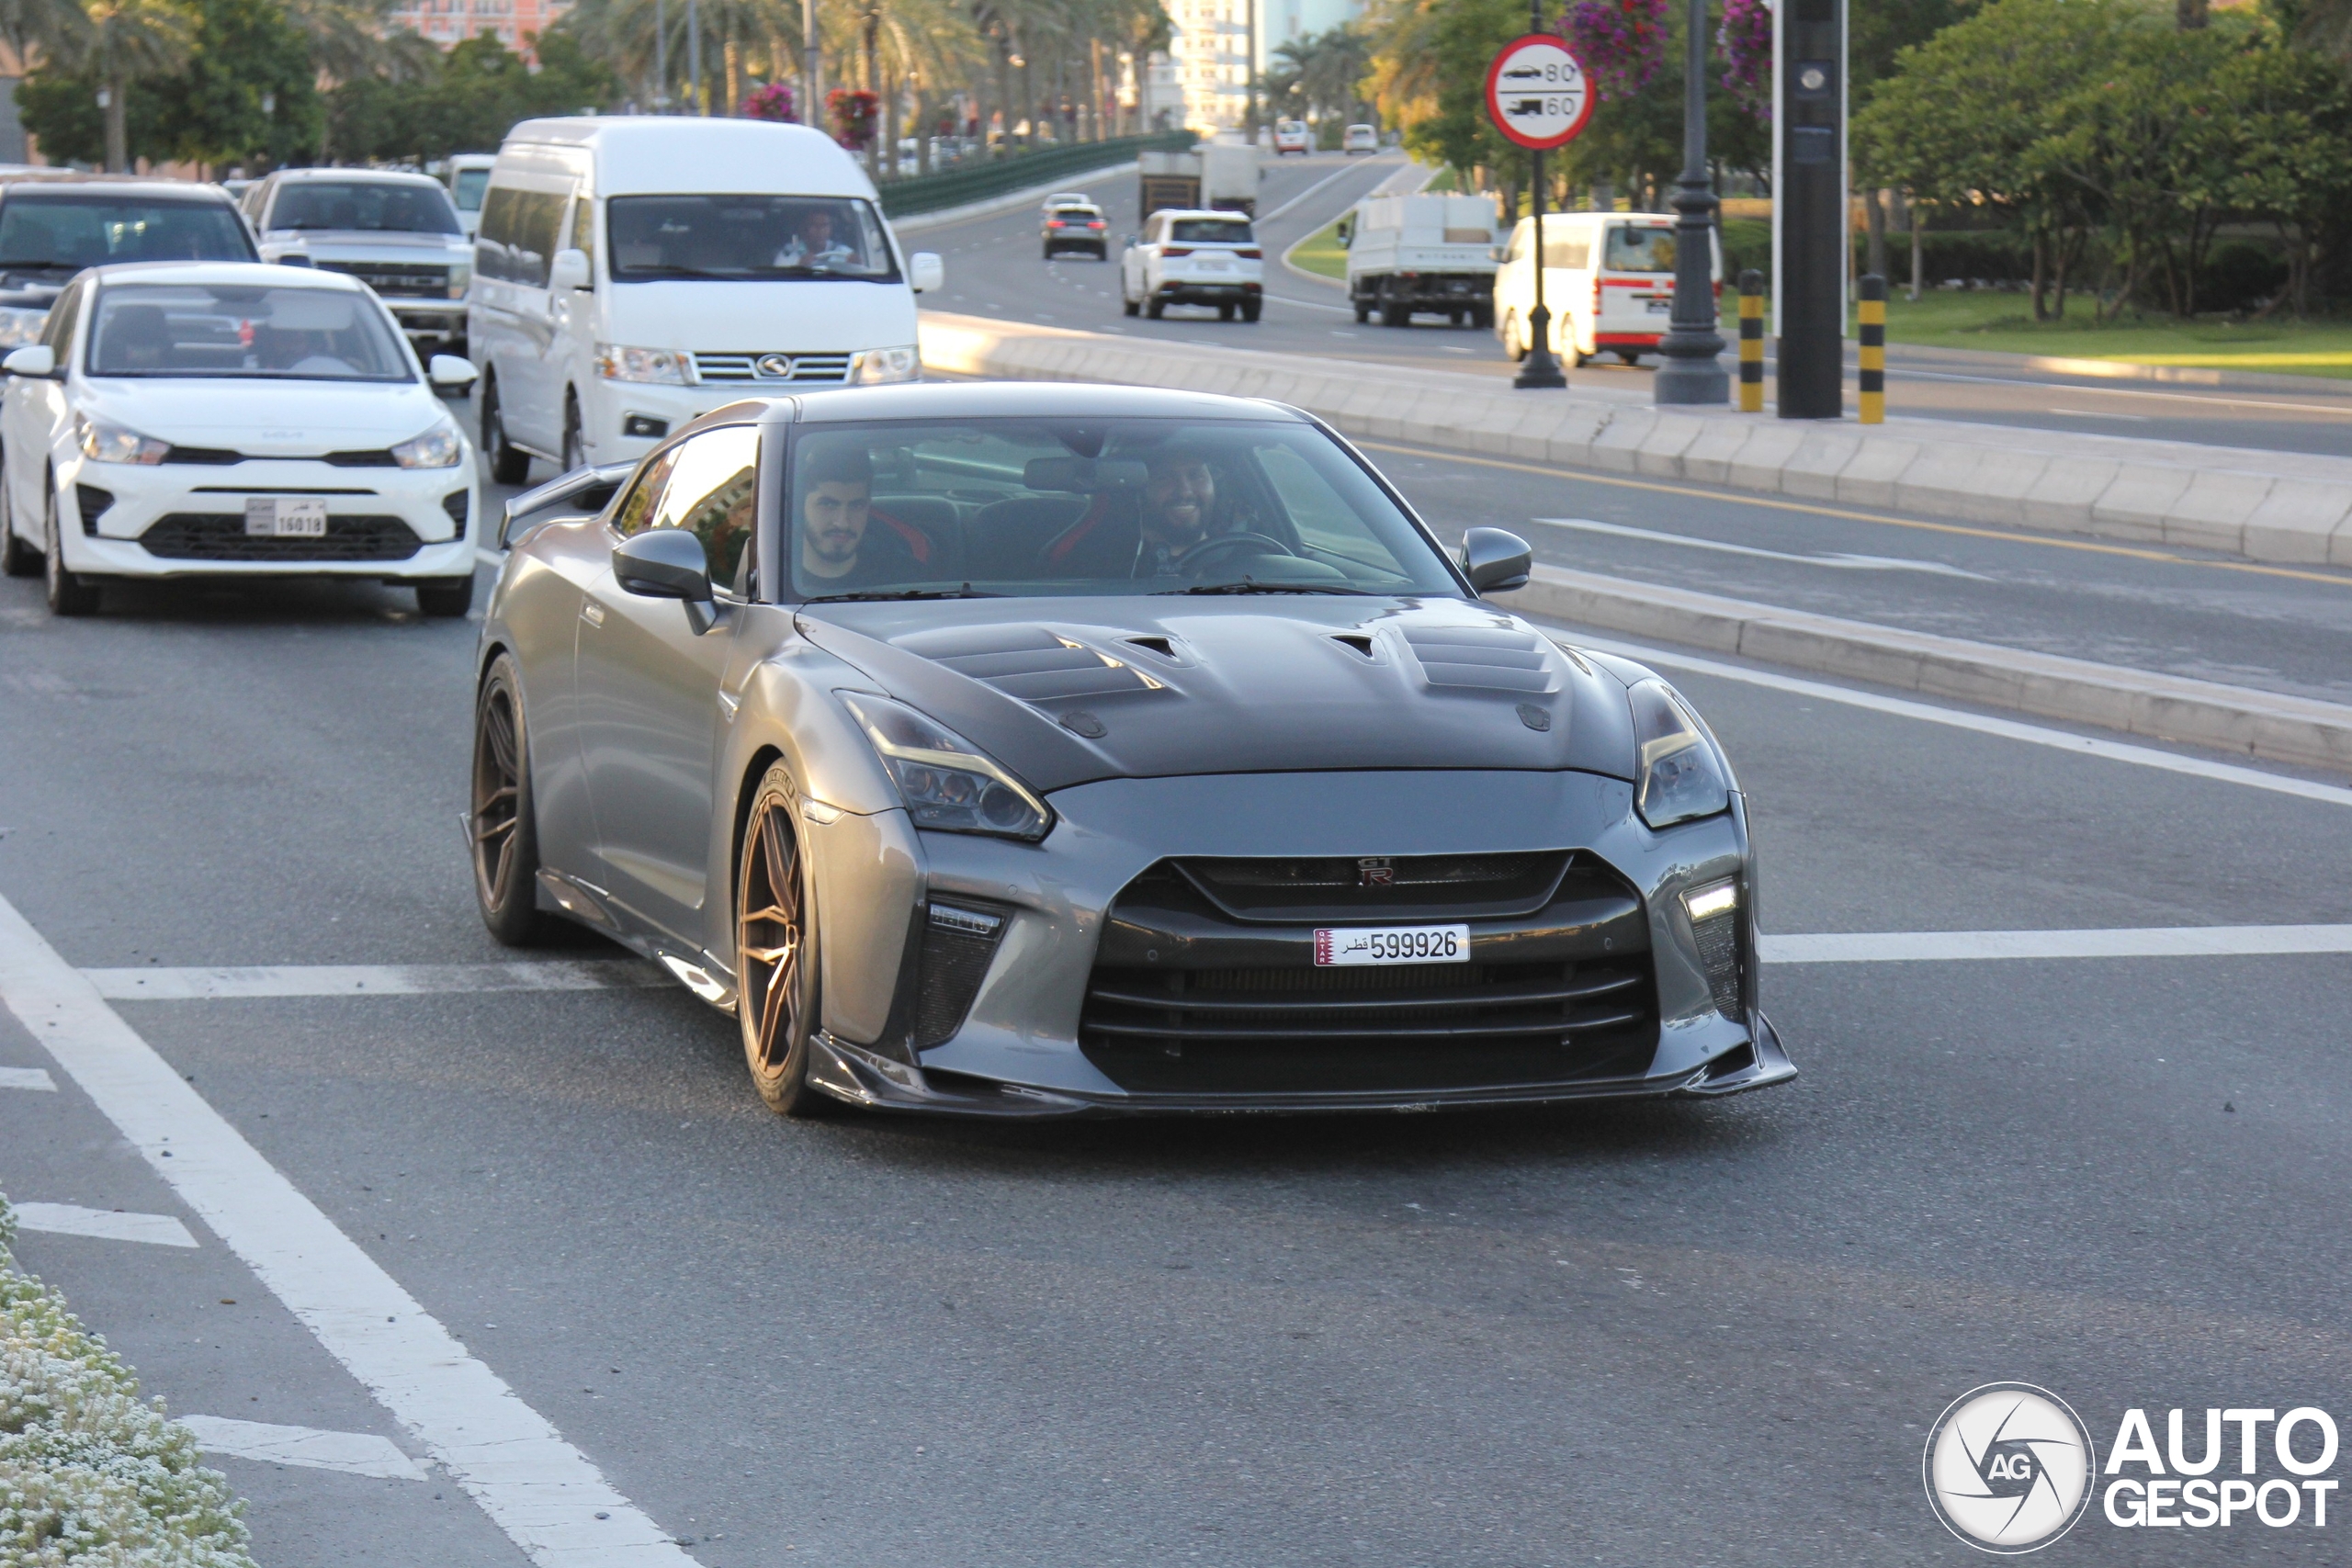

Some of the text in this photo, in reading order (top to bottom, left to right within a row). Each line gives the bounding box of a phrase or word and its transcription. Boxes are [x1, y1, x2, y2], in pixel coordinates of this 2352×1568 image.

[1545, 63, 1576, 82] 80
[1546, 97, 1575, 115] 60
[1340, 937, 1368, 954] قطر
[1371, 931, 1457, 959] 599926
